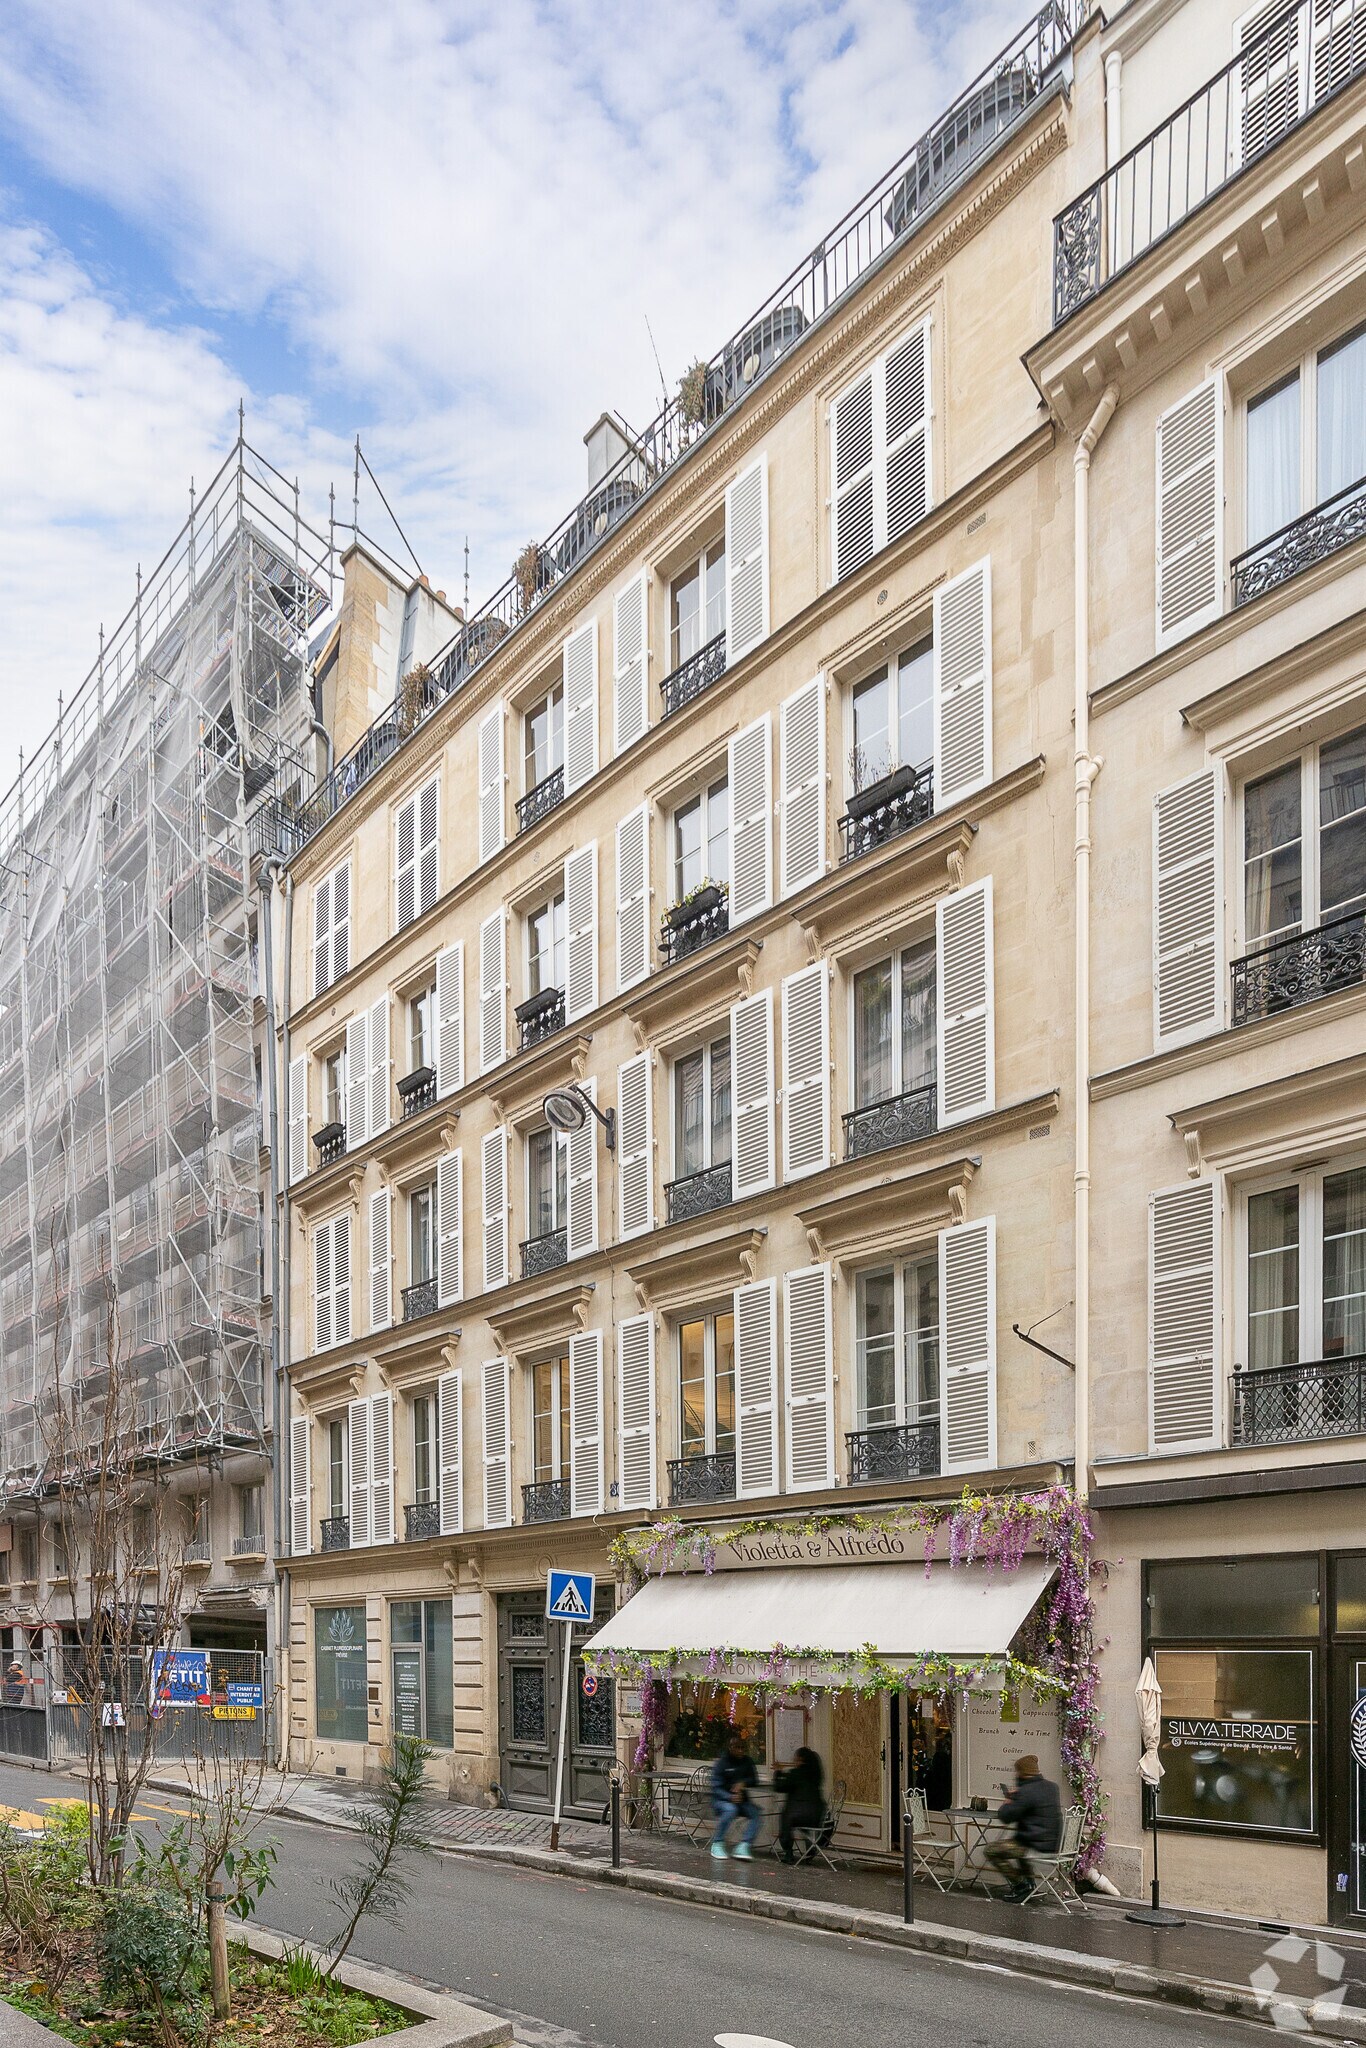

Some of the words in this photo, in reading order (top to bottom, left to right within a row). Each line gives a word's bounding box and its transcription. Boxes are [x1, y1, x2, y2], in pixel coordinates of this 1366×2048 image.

[730, 1541, 804, 1562] Violetta
[806, 1540, 821, 1558] &
[827, 1533, 905, 1557] Alfredo
[711, 1663, 756, 1675] SALON
[790, 1662, 818, 1678] THÉ
[1022, 1709, 1059, 1718] Cappuccino
[978, 1727, 1000, 1735] Brunch
[1168, 1720, 1297, 1741] SILVYA.TERRADE
[1002, 1746, 1024, 1754] Goûter
